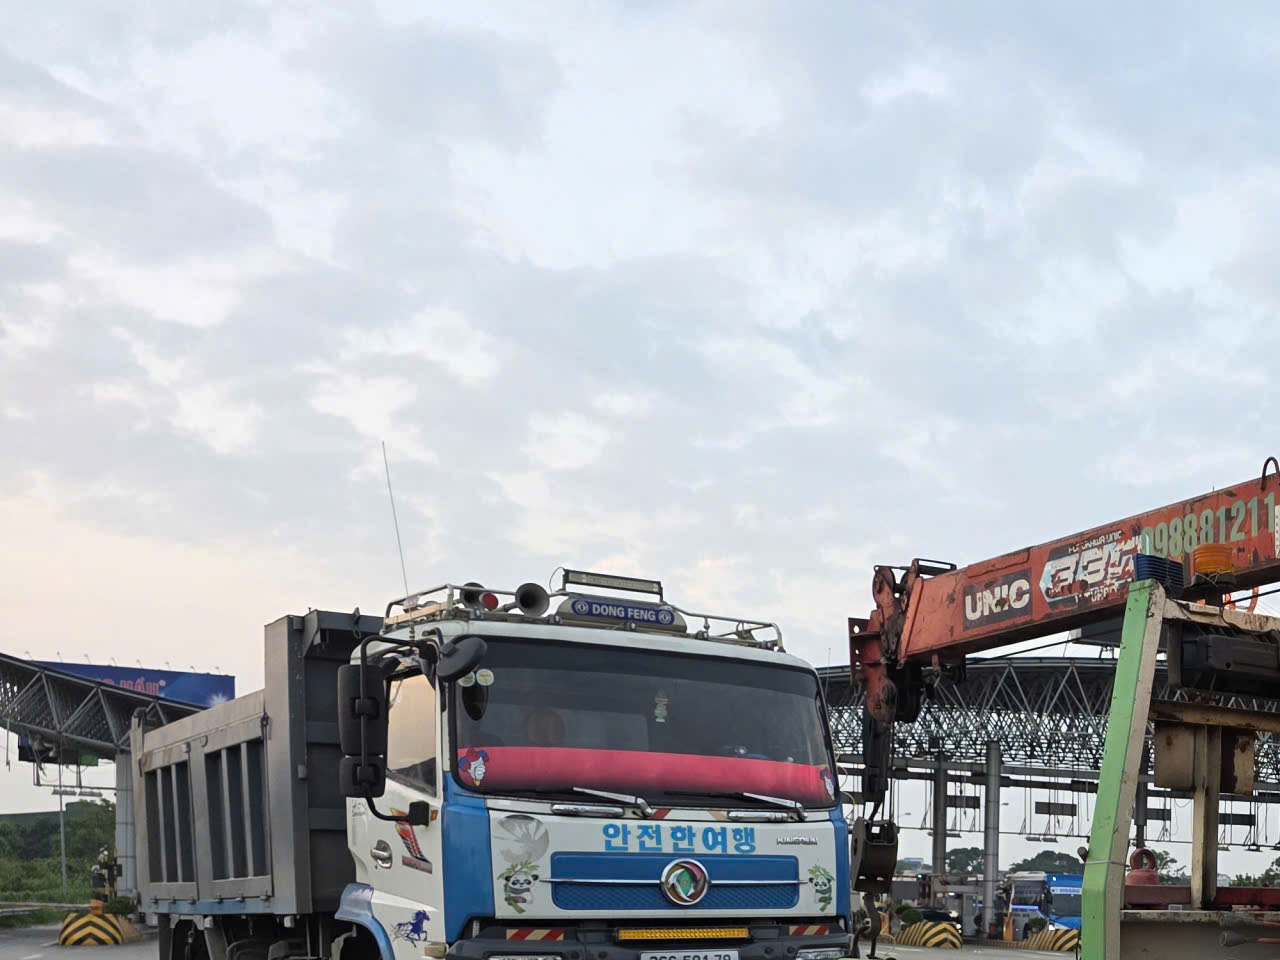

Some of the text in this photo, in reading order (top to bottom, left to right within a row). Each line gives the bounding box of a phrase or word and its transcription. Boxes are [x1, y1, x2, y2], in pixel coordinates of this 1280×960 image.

[592, 605, 655, 621] DONG FENG
[965, 578, 1030, 621] UNIC
